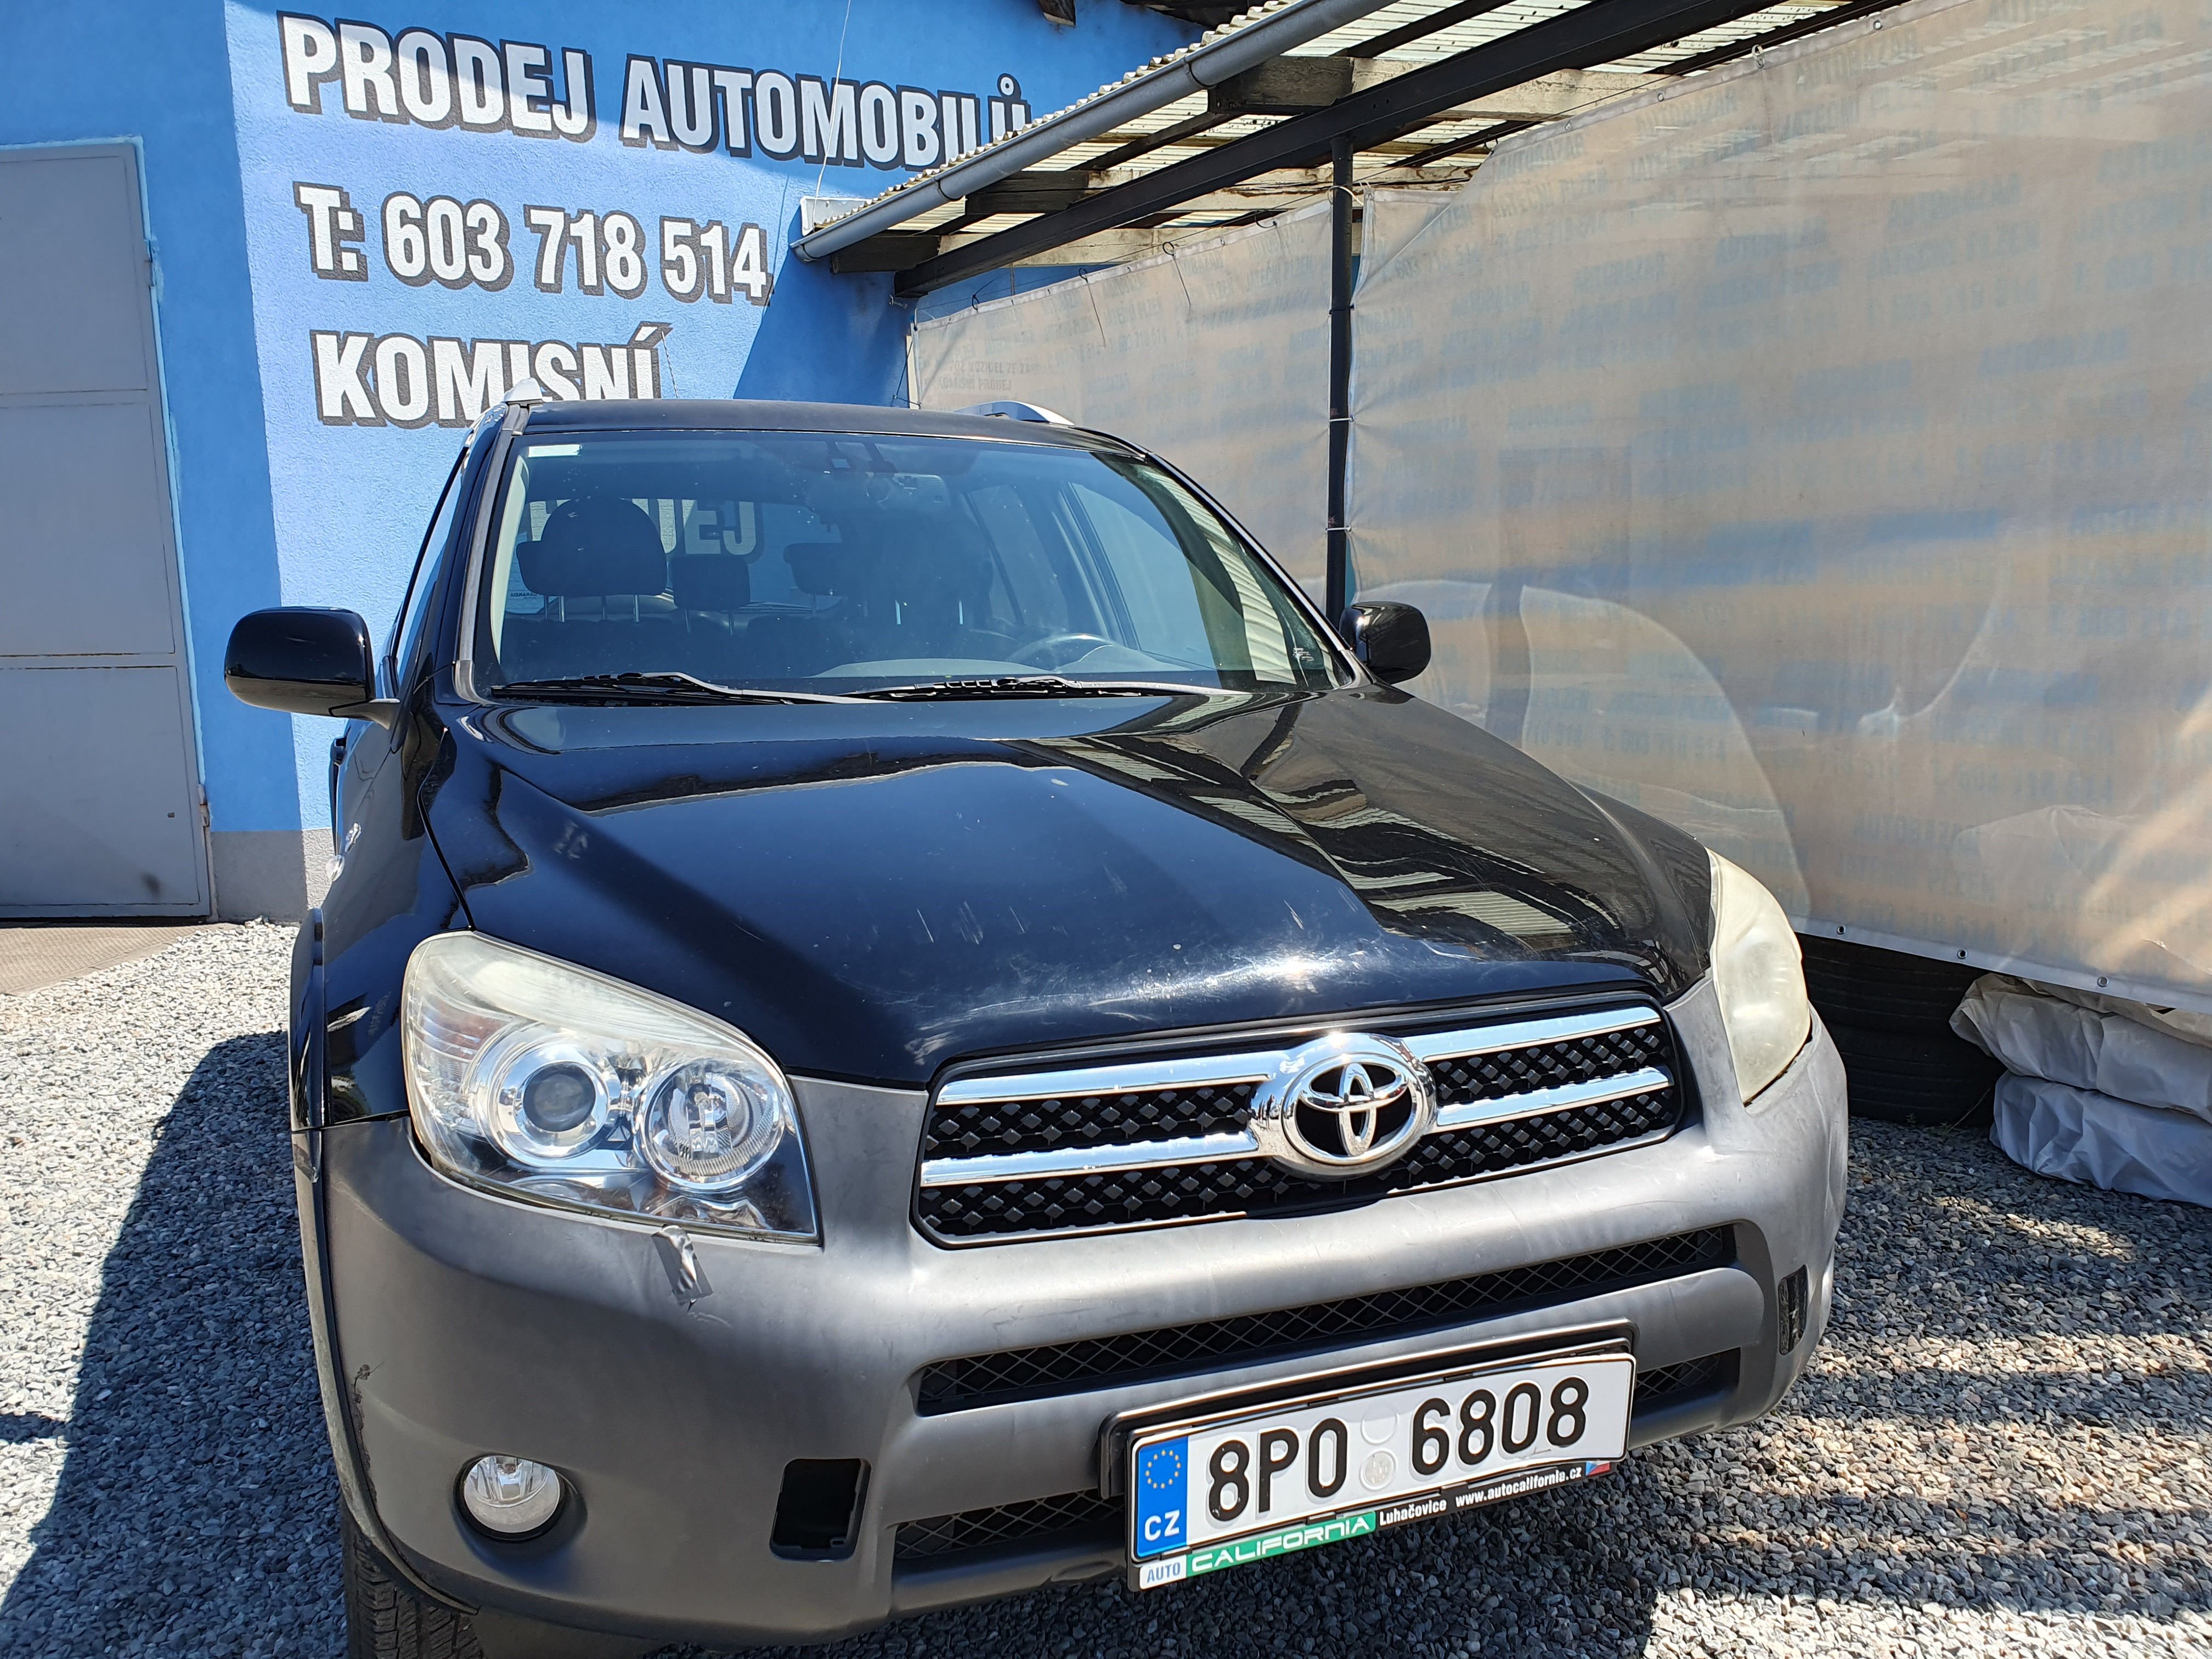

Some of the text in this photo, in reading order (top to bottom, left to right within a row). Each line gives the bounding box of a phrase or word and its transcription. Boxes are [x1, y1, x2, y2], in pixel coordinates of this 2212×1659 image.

[278, 11, 597, 143] PRODEJ
[294, 182, 771, 305] T: 603 718 514
[310, 321, 672, 428] KOMISNÍ
[1412, 1376, 1589, 1476] 6808
[1144, 1509, 1180, 1542] CZ
[1147, 1466, 1582, 1583] AUTO CALIFORNIA Luhačovice www.autocalifornia.cz
